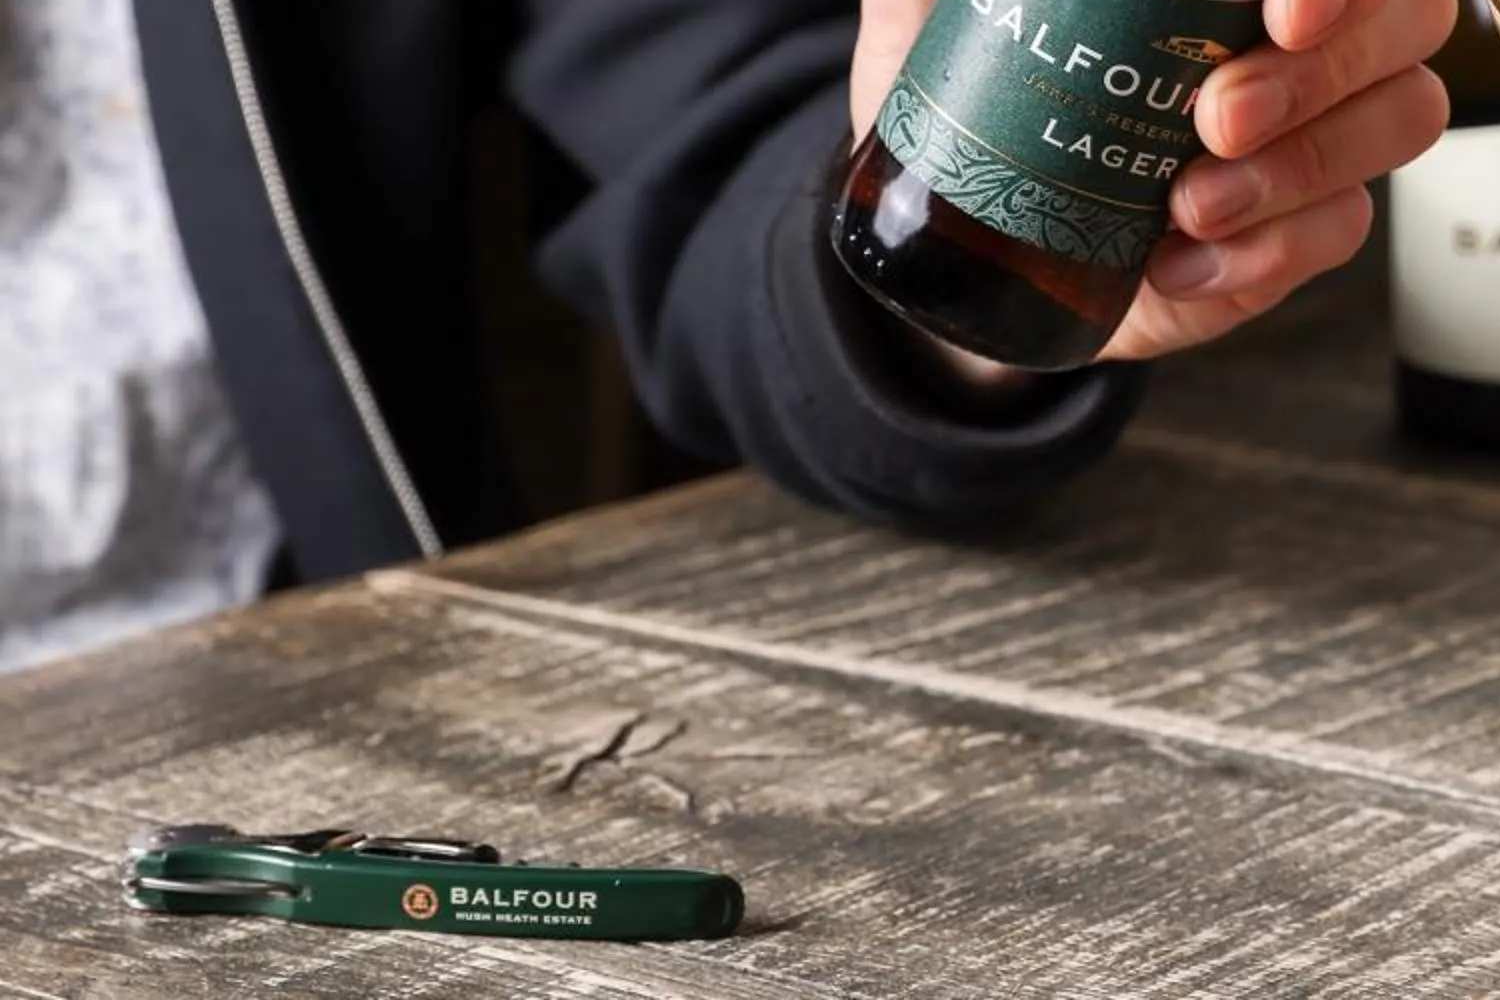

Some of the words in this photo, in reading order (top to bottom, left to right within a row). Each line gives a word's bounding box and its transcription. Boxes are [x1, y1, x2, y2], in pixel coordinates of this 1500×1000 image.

[1041, 117, 1179, 180] LAGER
[450, 886, 598, 909] BALFOUR
[455, 911, 491, 921] HUSH
[496, 913, 538, 923] HEATH
[543, 915, 592, 925] ESTATE
